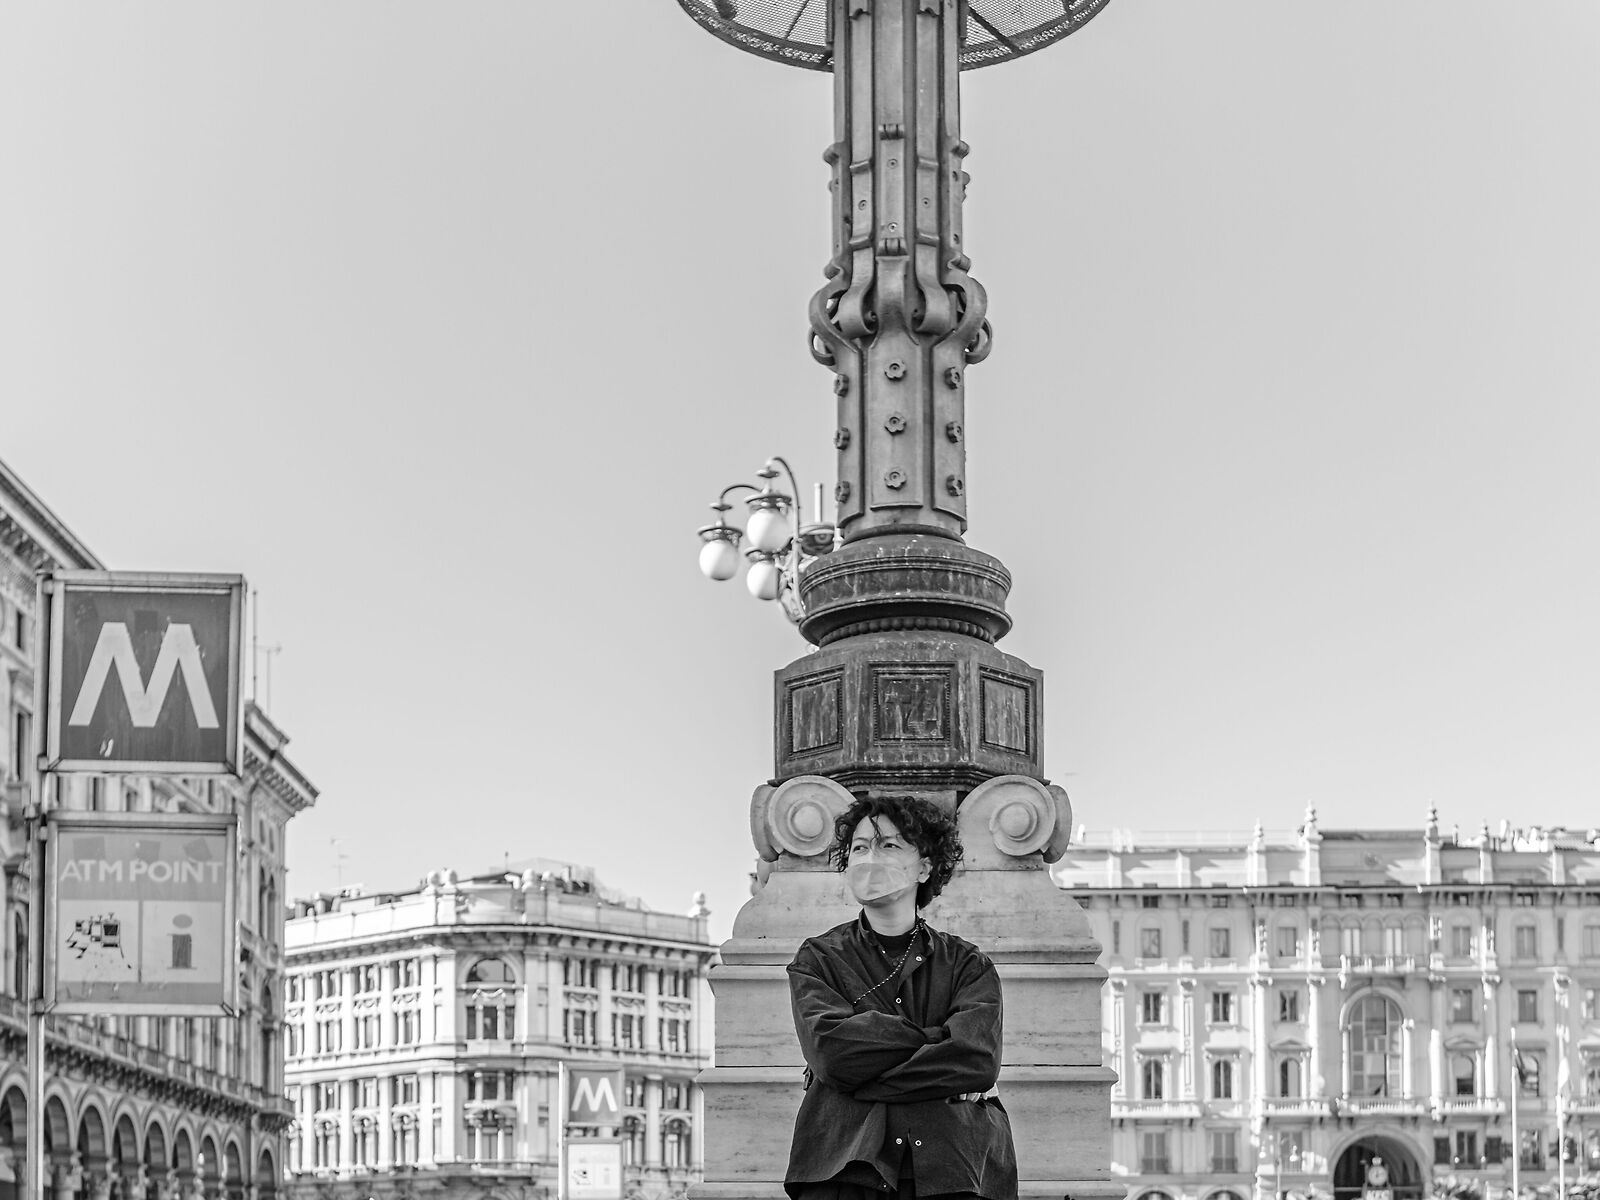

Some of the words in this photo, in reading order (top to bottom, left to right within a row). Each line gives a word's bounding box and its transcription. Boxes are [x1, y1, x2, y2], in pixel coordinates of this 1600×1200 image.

[68, 621, 220, 729] M
[60, 859, 123, 883] ATM
[129, 858, 223, 884] POINT
[571, 1077, 617, 1112] M
